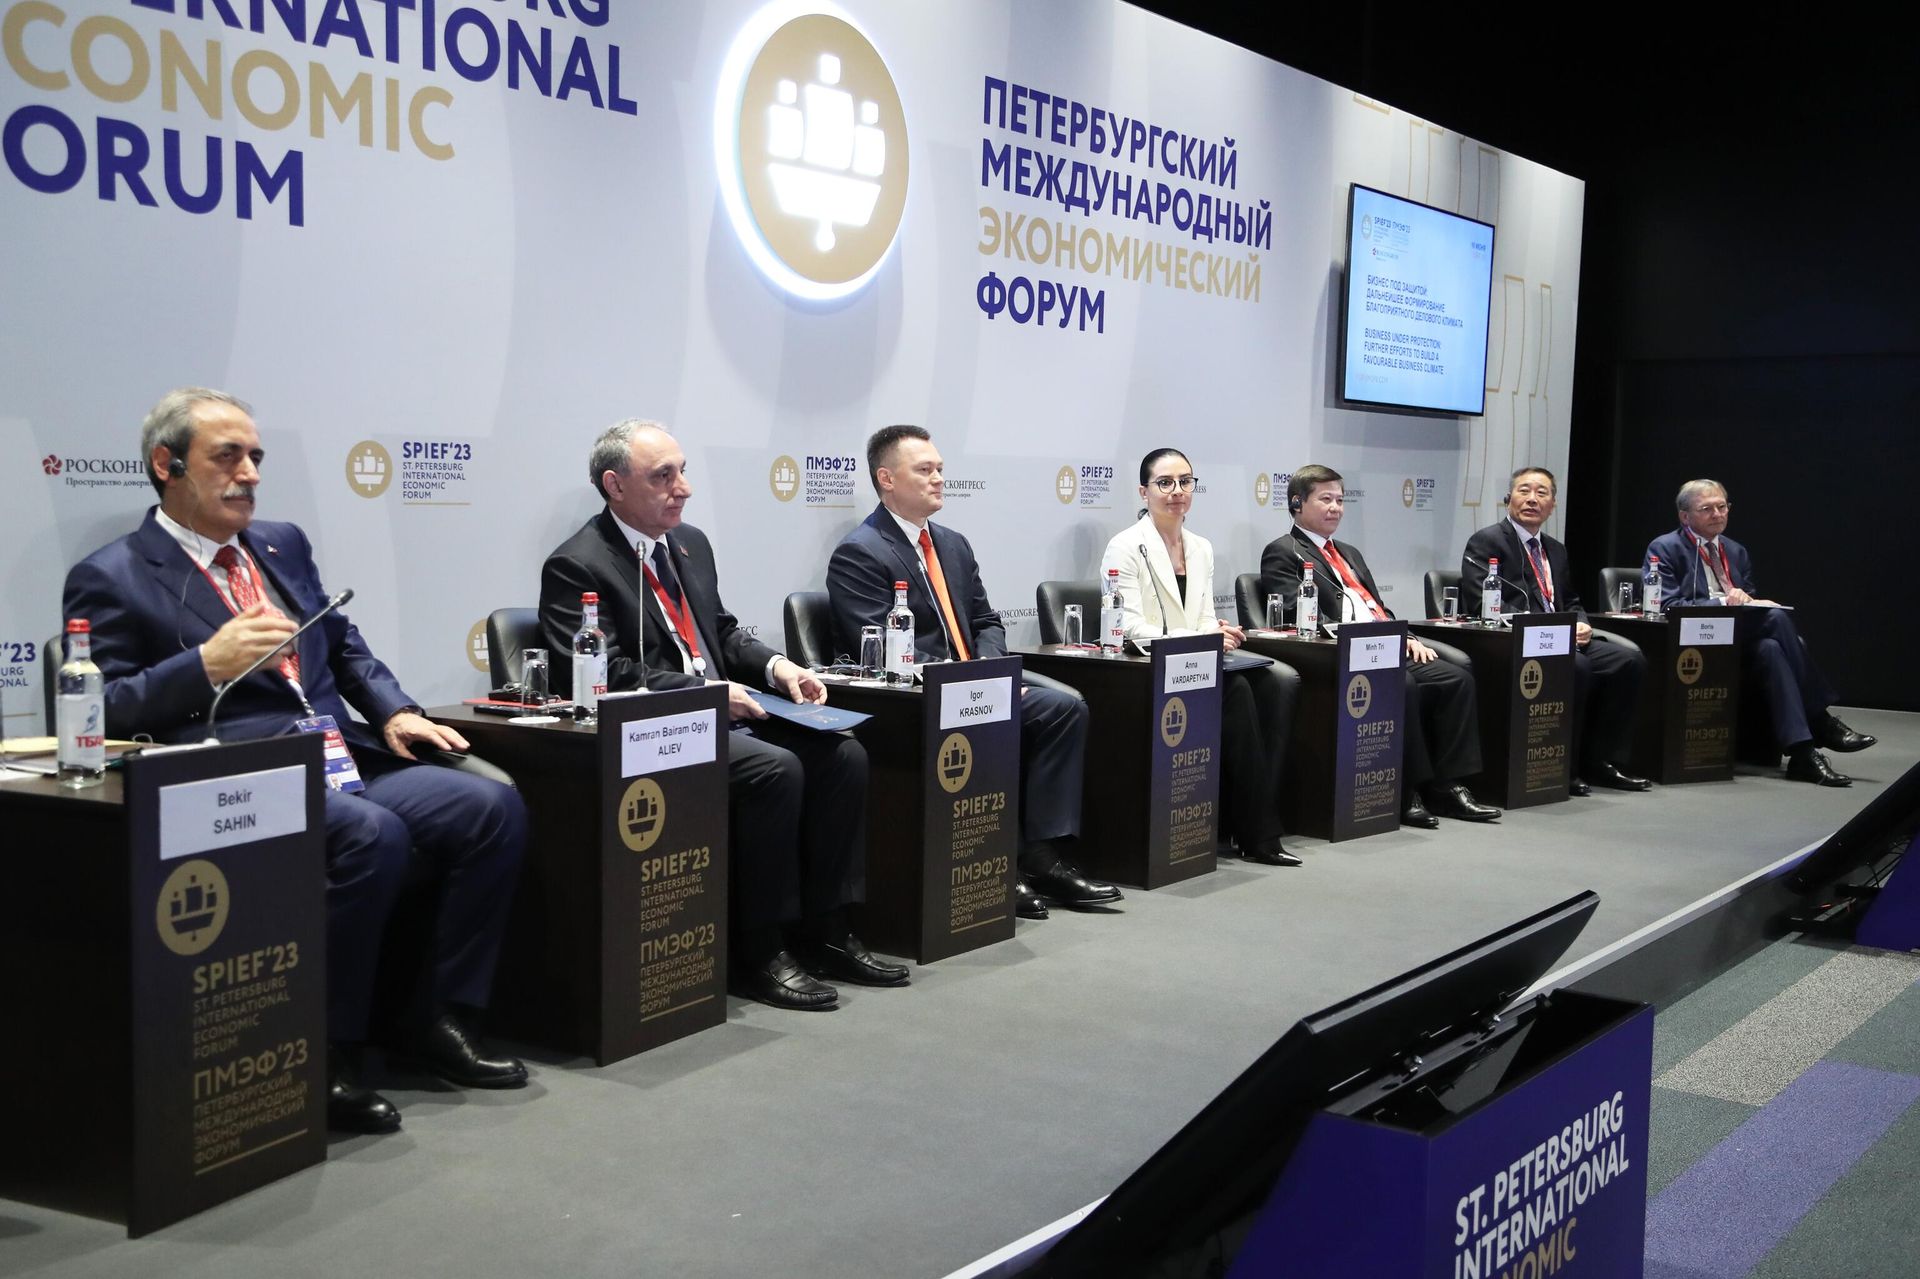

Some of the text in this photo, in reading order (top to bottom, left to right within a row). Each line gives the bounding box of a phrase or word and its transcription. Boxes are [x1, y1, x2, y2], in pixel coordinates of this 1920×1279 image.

[983, 75, 1237, 190] ПЕТЕРБУРГСКИЙ
[981, 138, 1272, 250] МЕЖДУНАРОДНЫЙ
[977, 206, 1261, 303] ЭКОНОМИЧЕСКИЙ
[976, 271, 1105, 334] ФОРУМ
[1364, 328, 1391, 341] BUSINESS
[1391, 333, 1409, 344] UNDER
[1364, 341, 1389, 354] FURTHER
[1389, 345, 1412, 358] EFFORTS
[1413, 349, 1420, 359] TO
[1421, 350, 1435, 361] BUILD
[1363, 354, 1444, 375] FAVOURABLE BUSINESS CLIMATE
[403, 441, 471, 460] SPIEF'23
[403, 462, 463, 471] ST. PETERSBURG
[403, 472, 466, 480] INTERNATIONAL
[806, 472, 848, 480] ПЕТЕРБУРГСКИЙ
[66, 477, 121, 488] Пространство
[806, 480, 855, 488] МЕЖДУНАРОДНЫЙ
[806, 488, 854, 496] ЭКОНОМИЧЕСКИЙ
[403, 491, 432, 499] FORUM
[1540, 631, 1553, 639] Zhang
[1185, 661, 1198, 669] Anna
[1371, 655, 1378, 663] LE
[1172, 673, 1209, 684] VARDAPETYAN
[970, 690, 983, 702] Igor
[960, 704, 993, 718] KRASNOV
[629, 721, 708, 742] Kamran Bairam Ogly
[658, 743, 682, 756] ALIEV
[218, 789, 252, 808] Bekir
[953, 791, 1006, 819] SPIEF'23
[213, 813, 256, 834] SAHIN
[962, 813, 999, 828] PETERSBURG
[952, 822, 1000, 840] INTERNATIONAL
[952, 835, 985, 850] ECONOMIC
[952, 847, 974, 861] FORUM
[641, 846, 710, 883] SPIEF'23
[653, 872, 702, 893] PETERSBURG
[641, 885, 704, 909] INTERNATIONAL
[641, 900, 684, 921] ECONOMIC
[641, 916, 670, 934] FORUM
[193, 941, 299, 994] SPIEF'23
[640, 947, 705, 978] ПЕТЕРБУРГСКИЙ
[640, 956, 714, 990] МЕЖДУНАРОДНЫЙ
[212, 975, 287, 1005] PETERSBURG
[640, 969, 713, 1002] ЭКОНОМИЧЕСКИЙ
[193, 990, 291, 1028] INTERNATIONAL
[640, 996, 670, 1013] ФОРУМ
[193, 1013, 260, 1045] ECONOMIC
[193, 1034, 239, 1060] FORUM
[1455, 1090, 1624, 1247] ST. PETERSBURG
[1454, 1133, 1630, 1279] INTERNATIONAL
